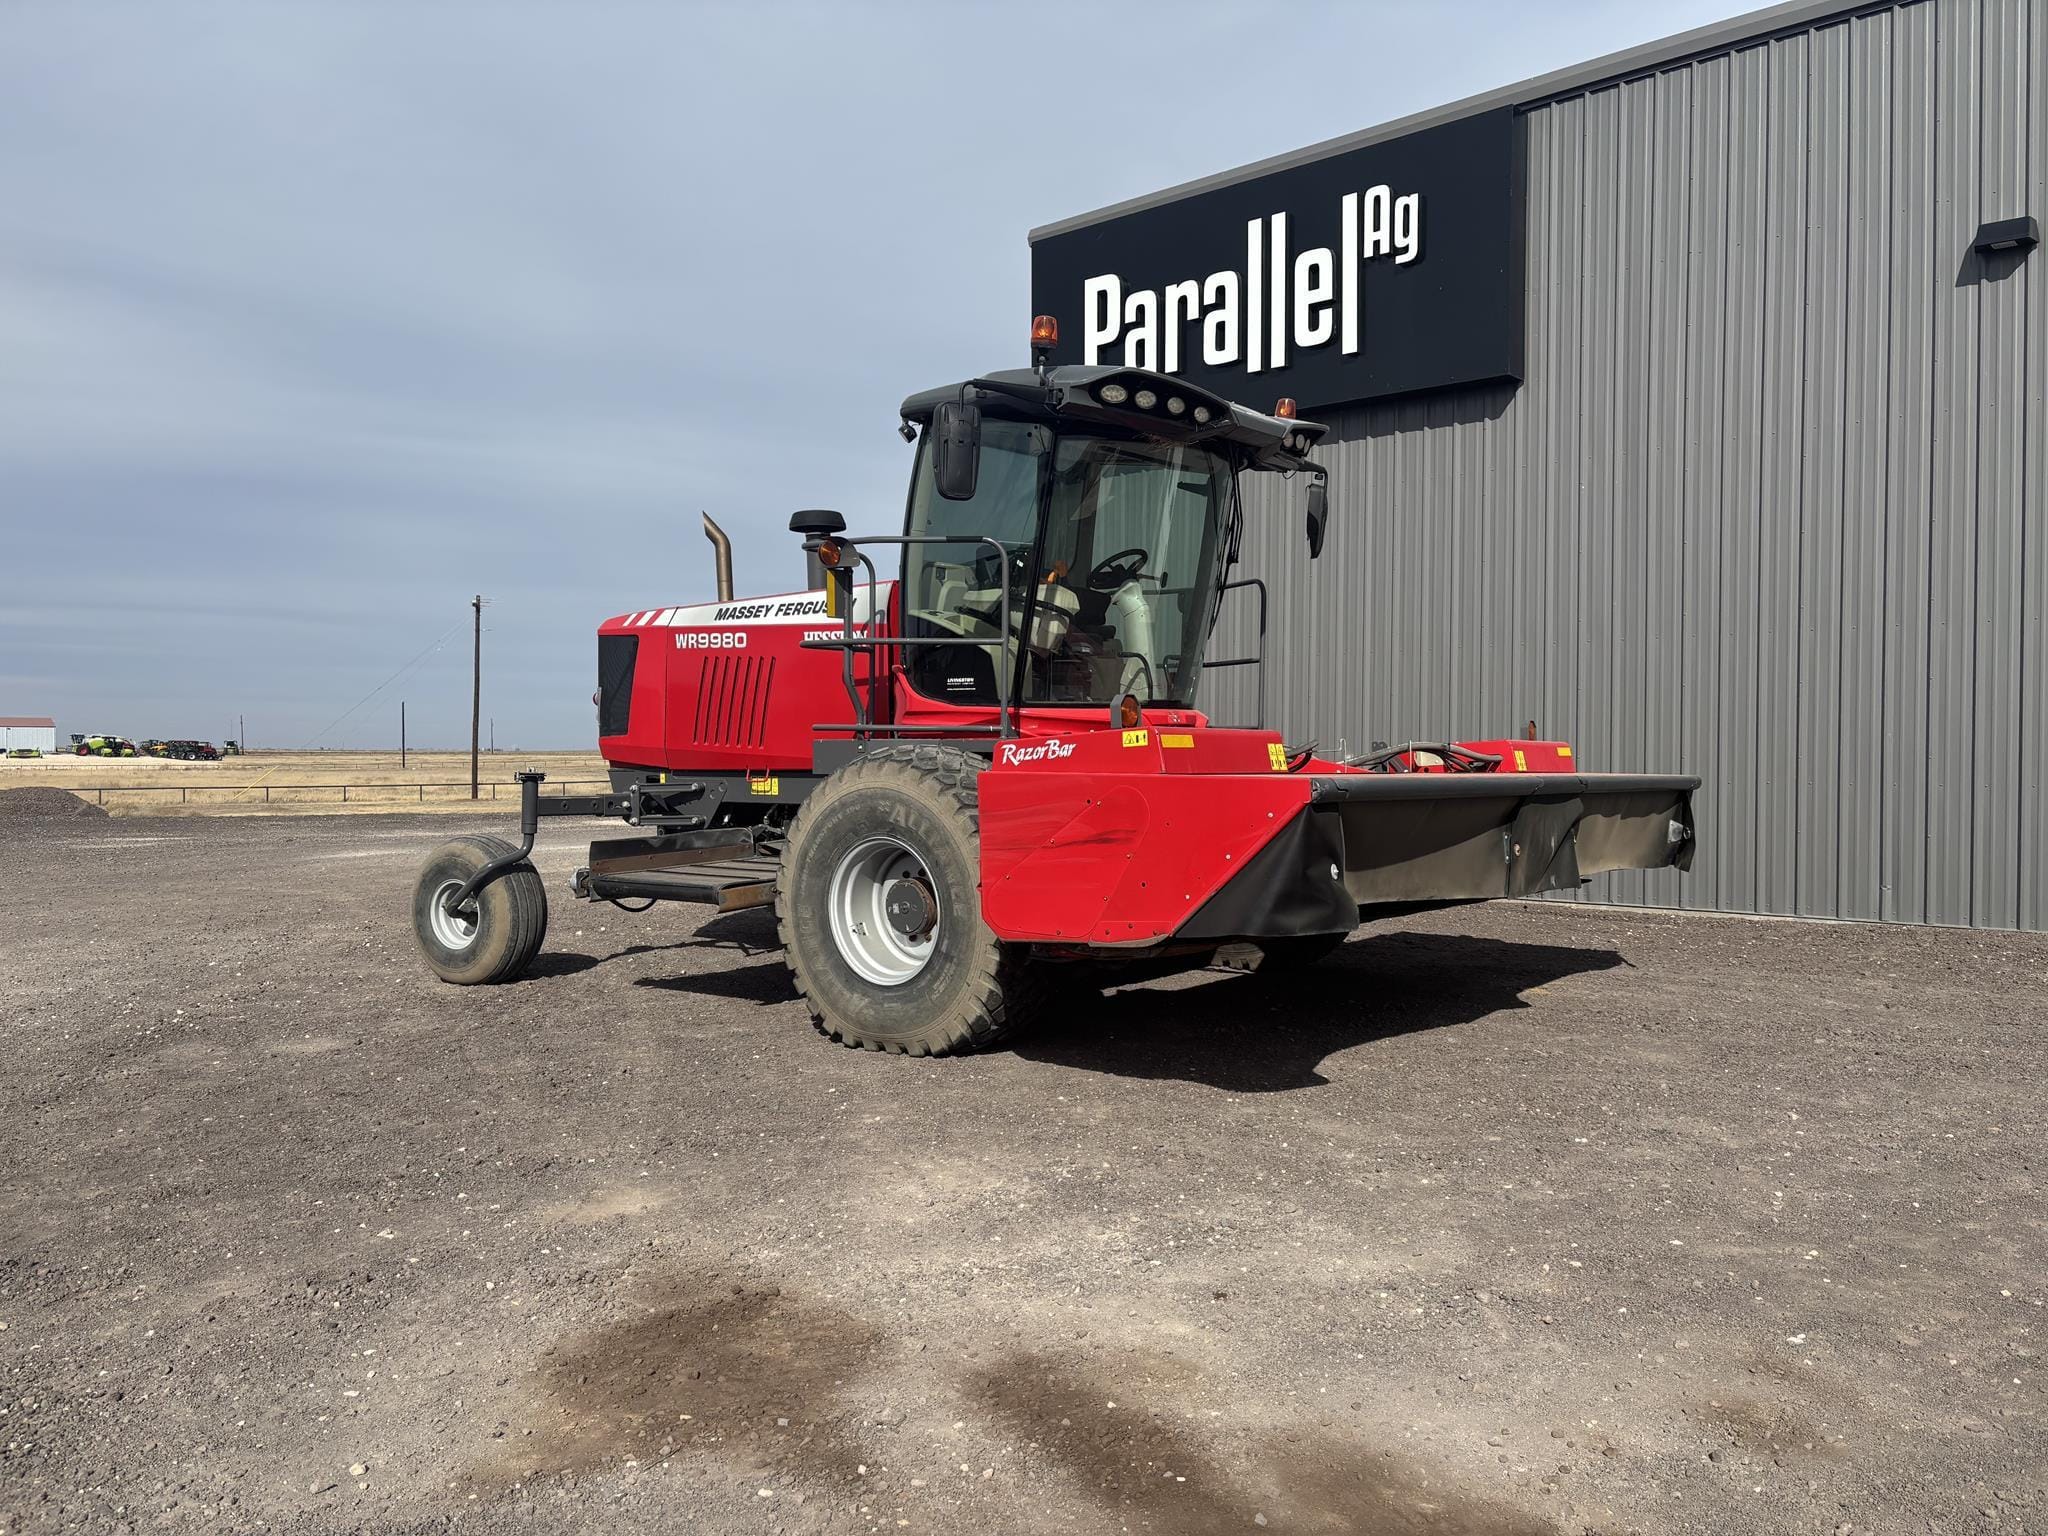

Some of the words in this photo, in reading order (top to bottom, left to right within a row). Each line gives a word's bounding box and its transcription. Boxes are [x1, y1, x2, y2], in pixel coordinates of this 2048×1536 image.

[1084, 192, 1359, 373] Parallel
[1363, 184, 1419, 264] Ag
[714, 604, 774, 621] MASSEY
[775, 598, 857, 617] FERGUS
[675, 632, 747, 650] WR9980
[1001, 739, 1077, 766] RazorBar
